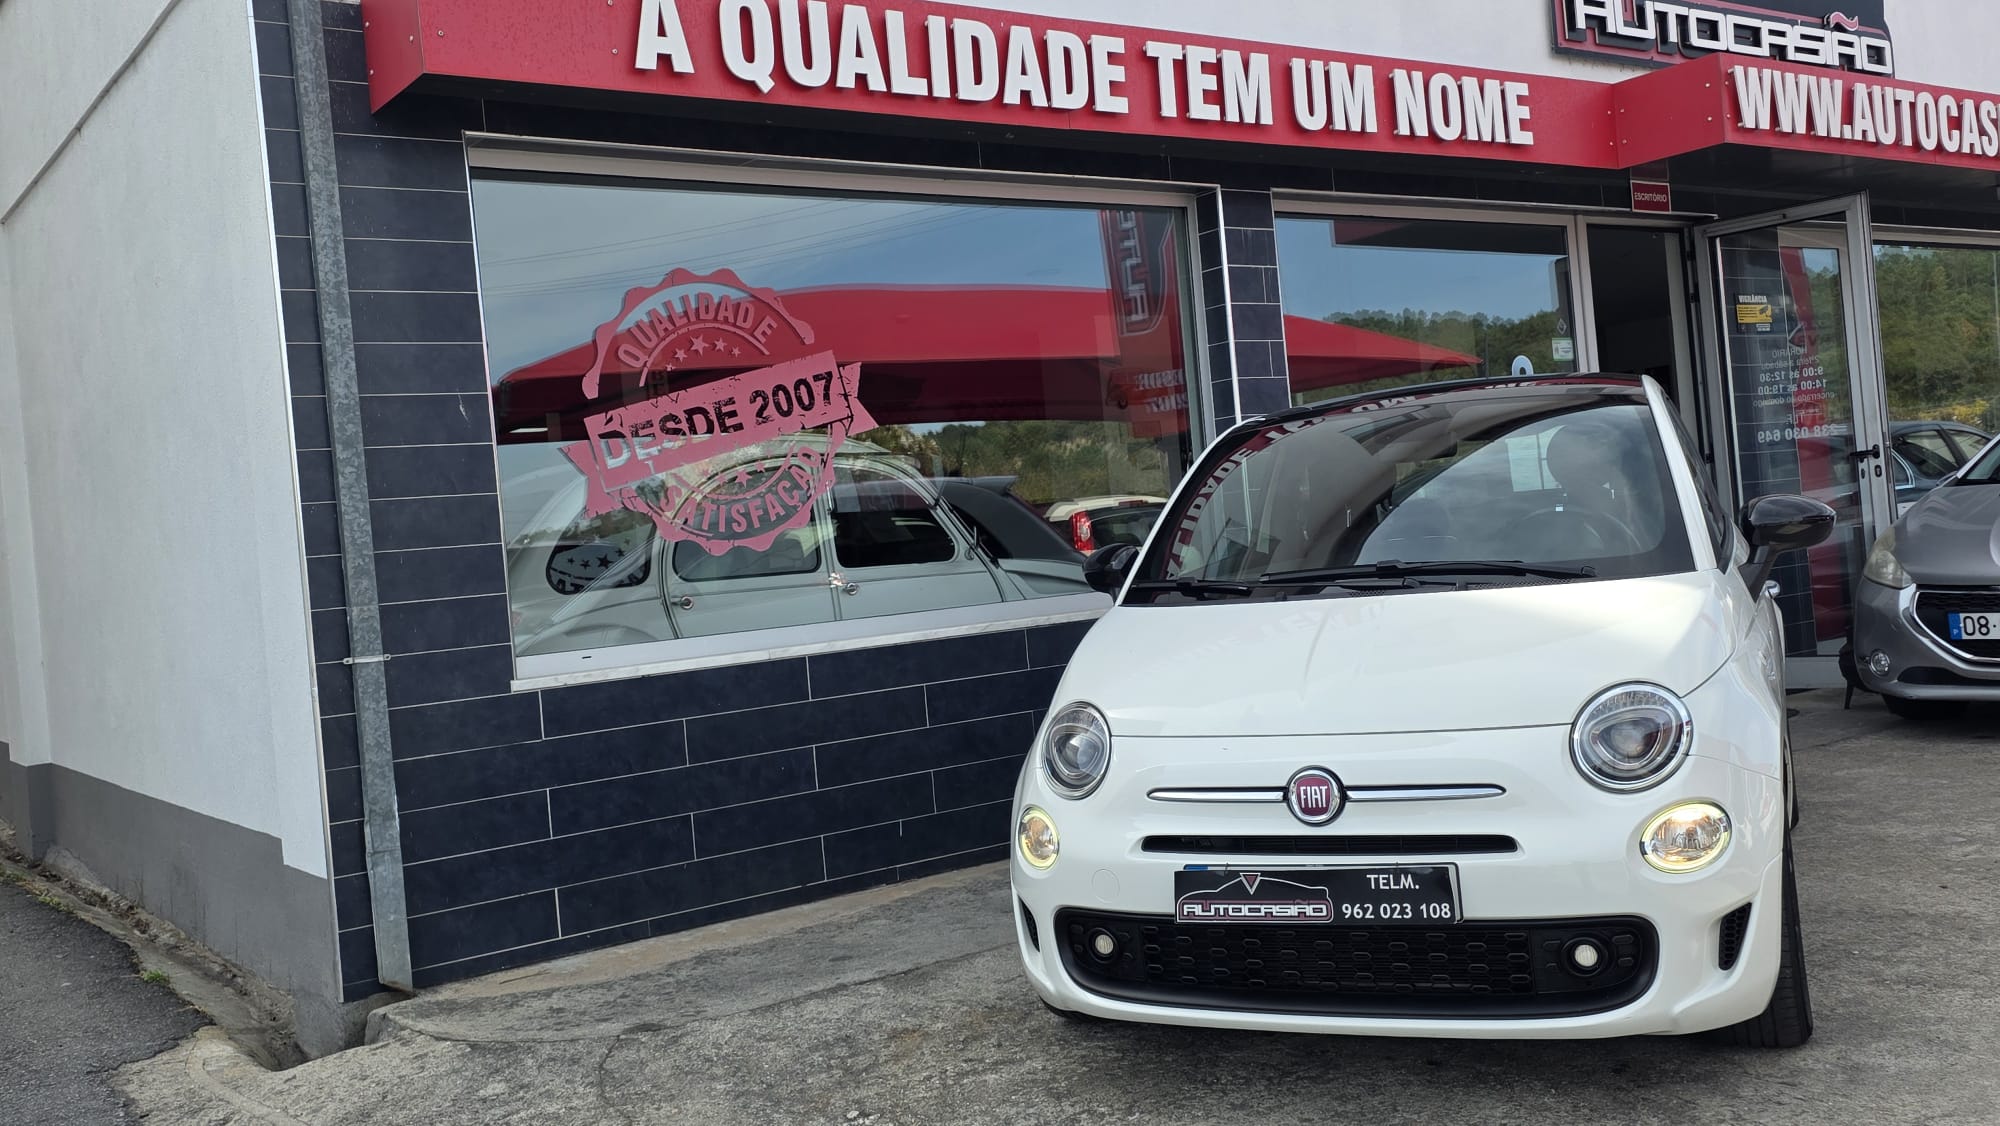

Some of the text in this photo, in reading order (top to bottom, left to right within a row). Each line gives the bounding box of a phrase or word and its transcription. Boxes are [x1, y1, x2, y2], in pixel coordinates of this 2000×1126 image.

[635, 0, 1534, 145] A QUALIDADE TEM UM NOME
[1734, 65, 2000, 157] WWW.AUTOCAS
[618, 292, 778, 368] QUALIDADE
[598, 371, 834, 470] DESDE 2007
[1300, 785, 1328, 808] FIAT
[1367, 874, 1420, 890] TELM.
[1183, 899, 1327, 917] AUTOCASIÃO
[1342, 903, 1451, 919] 962 023 108
